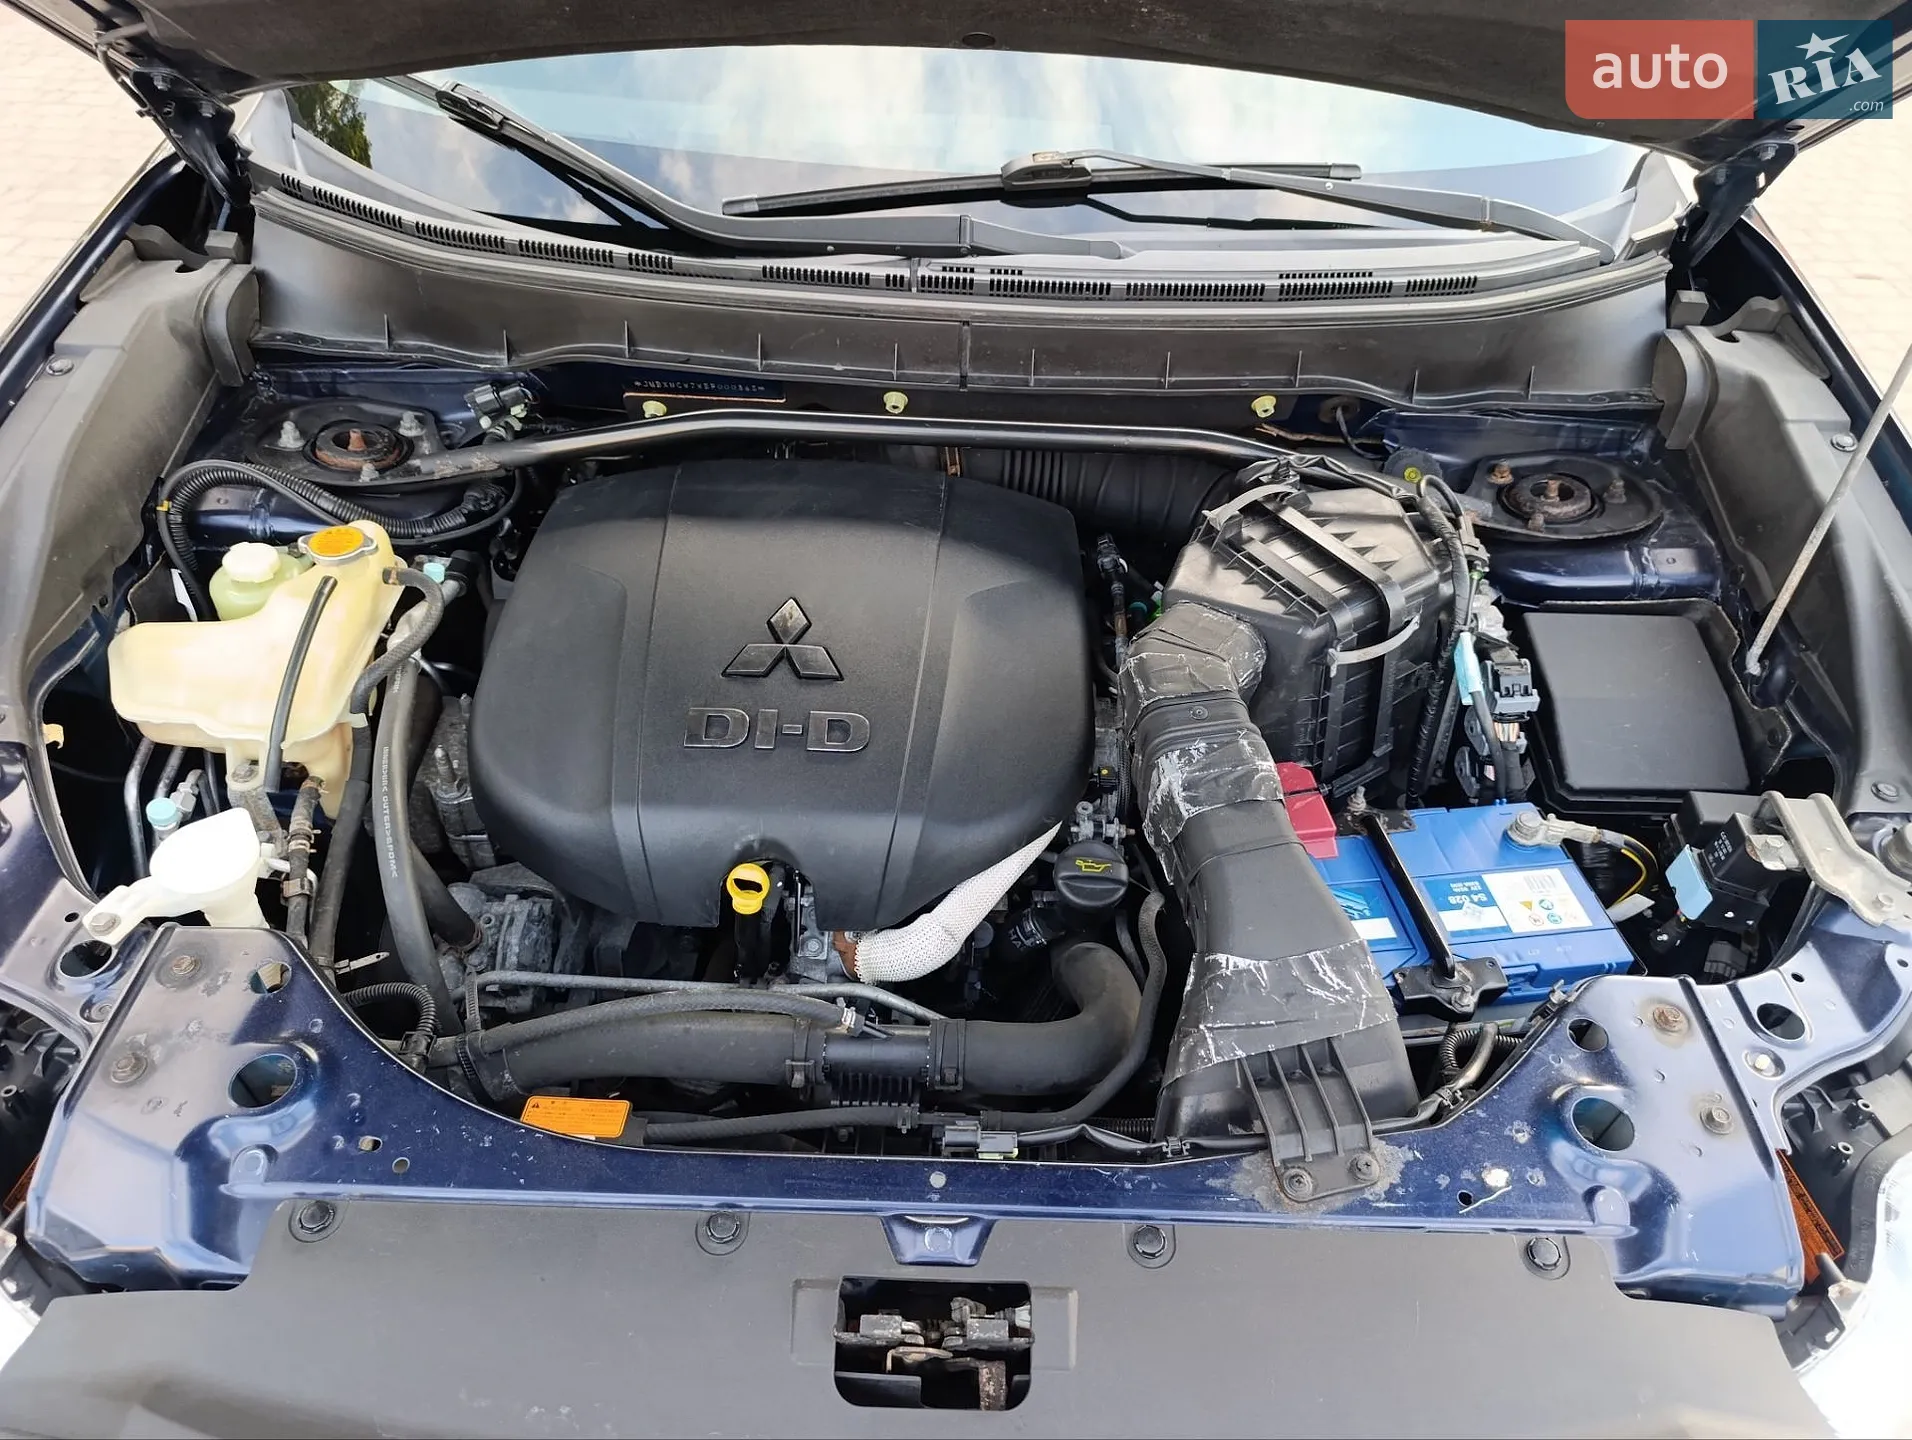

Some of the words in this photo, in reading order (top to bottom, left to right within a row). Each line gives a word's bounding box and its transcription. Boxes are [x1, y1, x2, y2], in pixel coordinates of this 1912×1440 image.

[684, 707, 871, 752] DI-D
[1448, 894, 1470, 905] 028
[1470, 892, 1488, 902] S4
